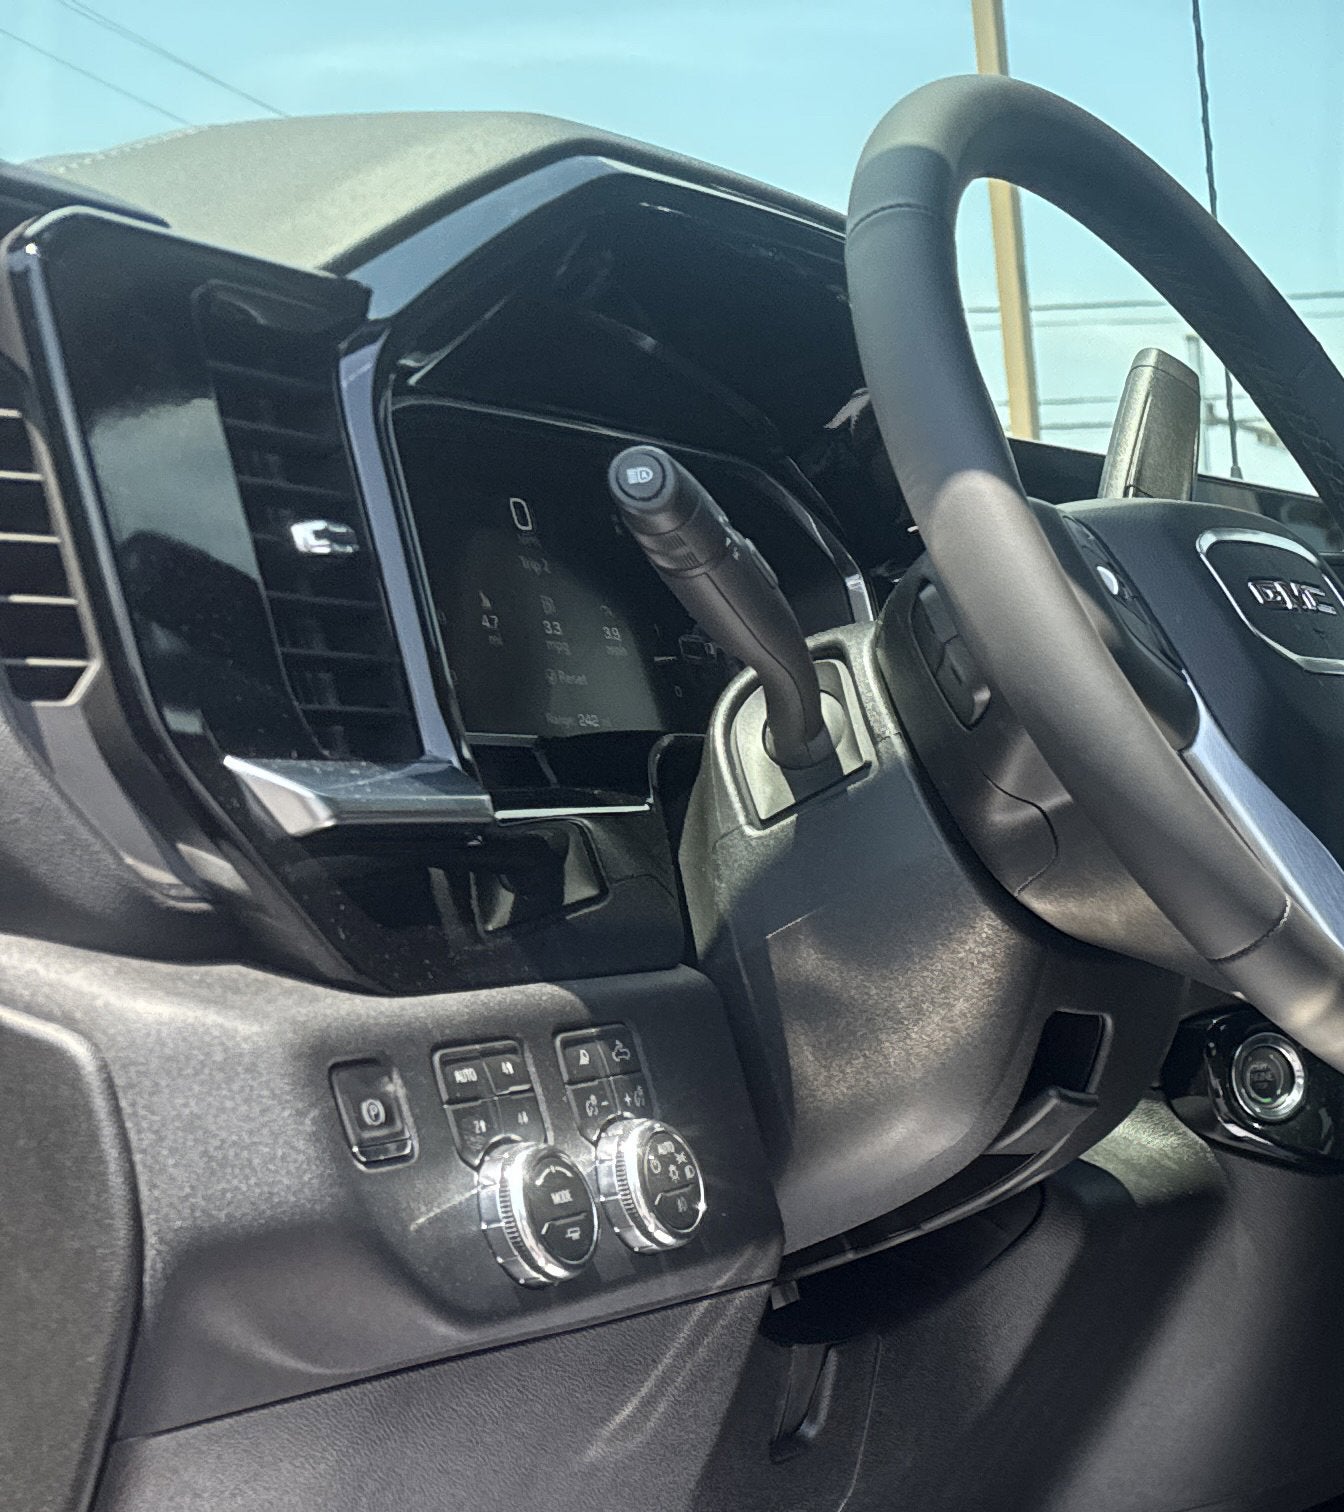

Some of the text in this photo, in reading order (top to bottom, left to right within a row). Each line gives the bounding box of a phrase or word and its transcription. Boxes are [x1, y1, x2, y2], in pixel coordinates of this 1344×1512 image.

[509, 497, 533, 531] 0
[1247, 578, 1337, 615] GMC
[577, 713, 600, 727] 242
[453, 1067, 478, 1083] AUTO
[657, 1141, 675, 1155] AUTO
[550, 1189, 573, 1205] MODE
